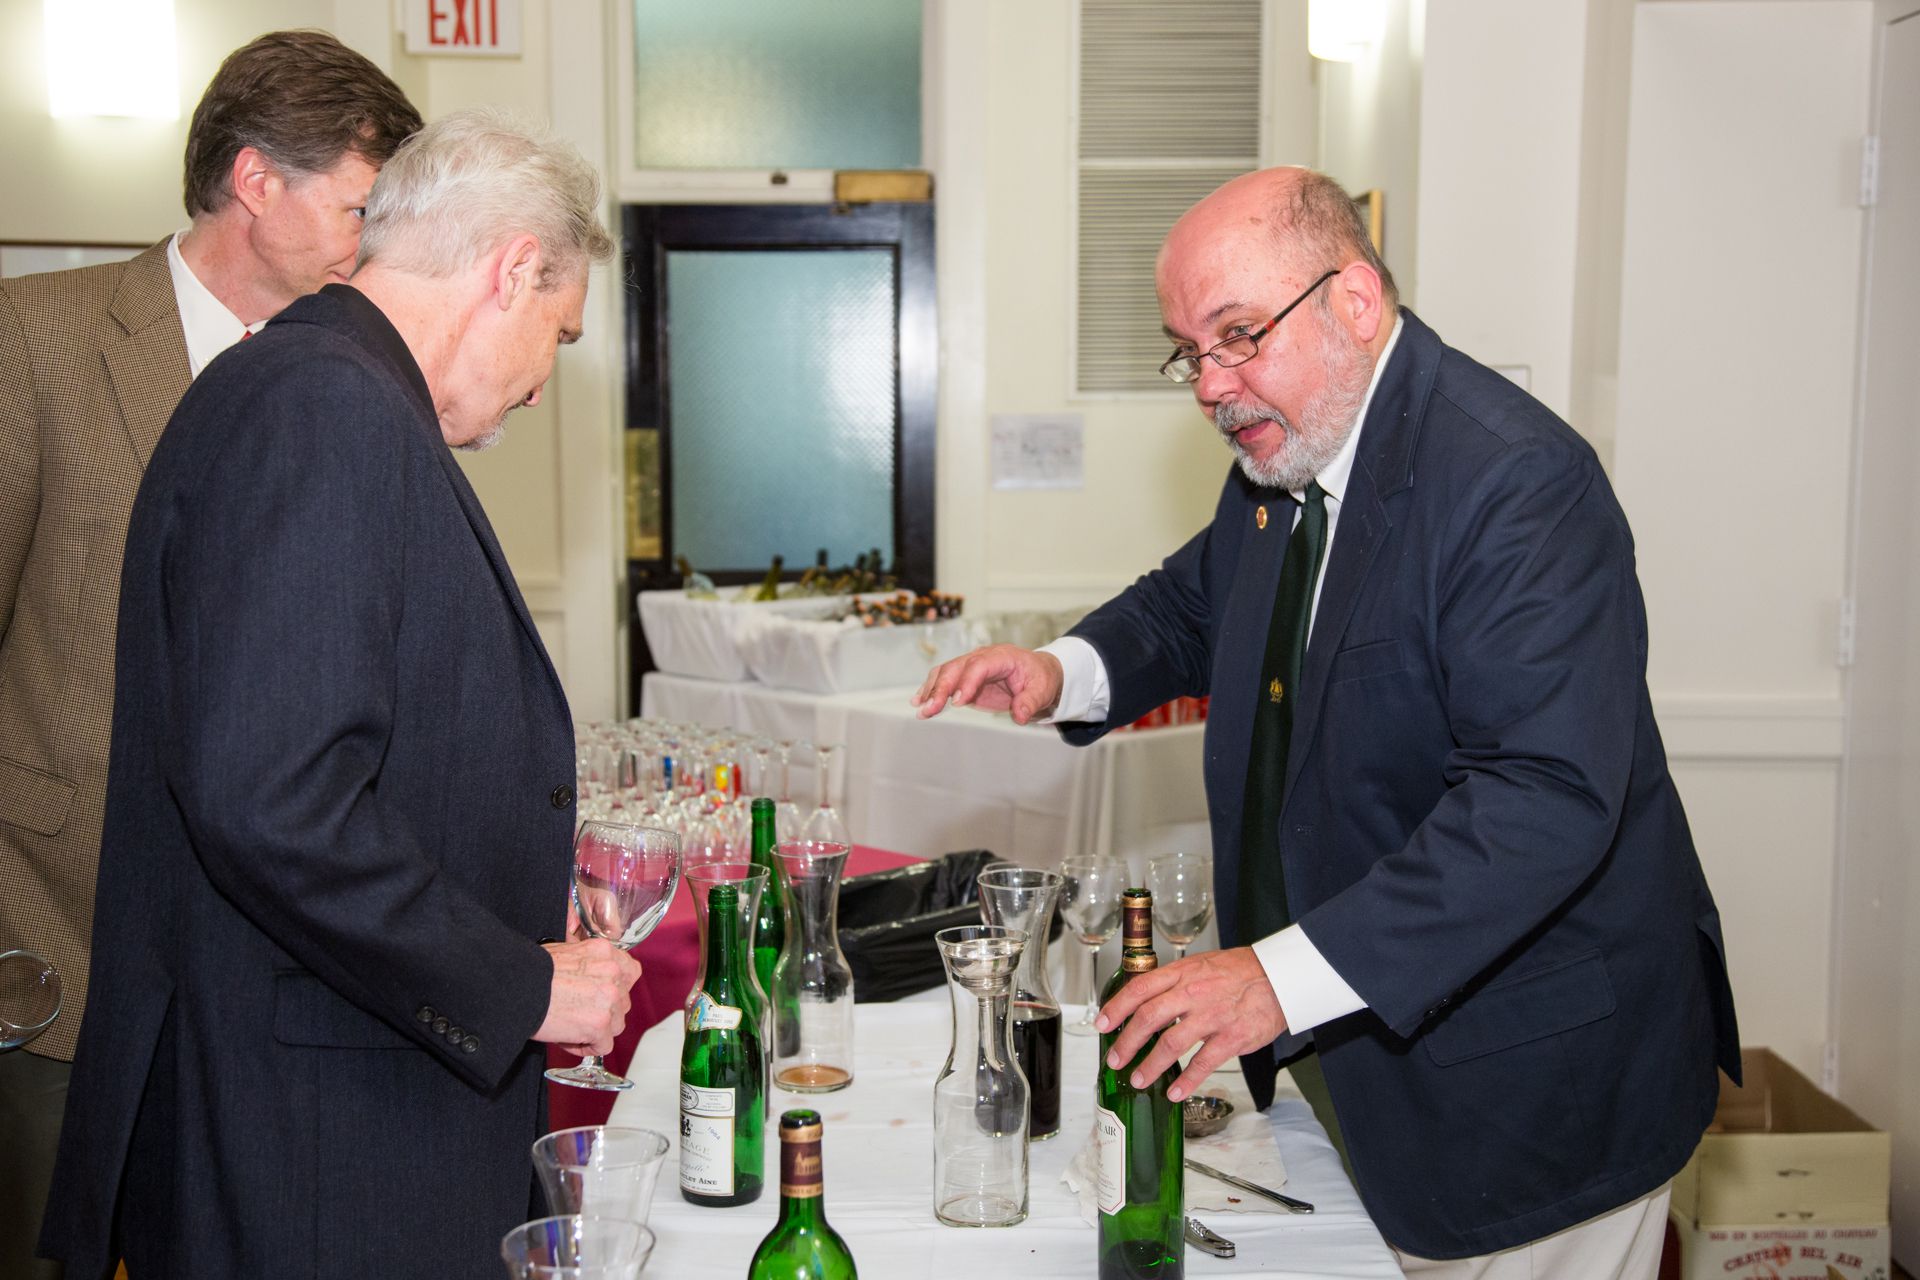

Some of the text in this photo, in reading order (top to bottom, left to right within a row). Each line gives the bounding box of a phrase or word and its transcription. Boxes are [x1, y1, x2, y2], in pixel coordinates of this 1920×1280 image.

[428, 0, 498, 46] EXIT
[1799, 1246, 1828, 1260] BEL
[1835, 1252, 1863, 1269] AIR
